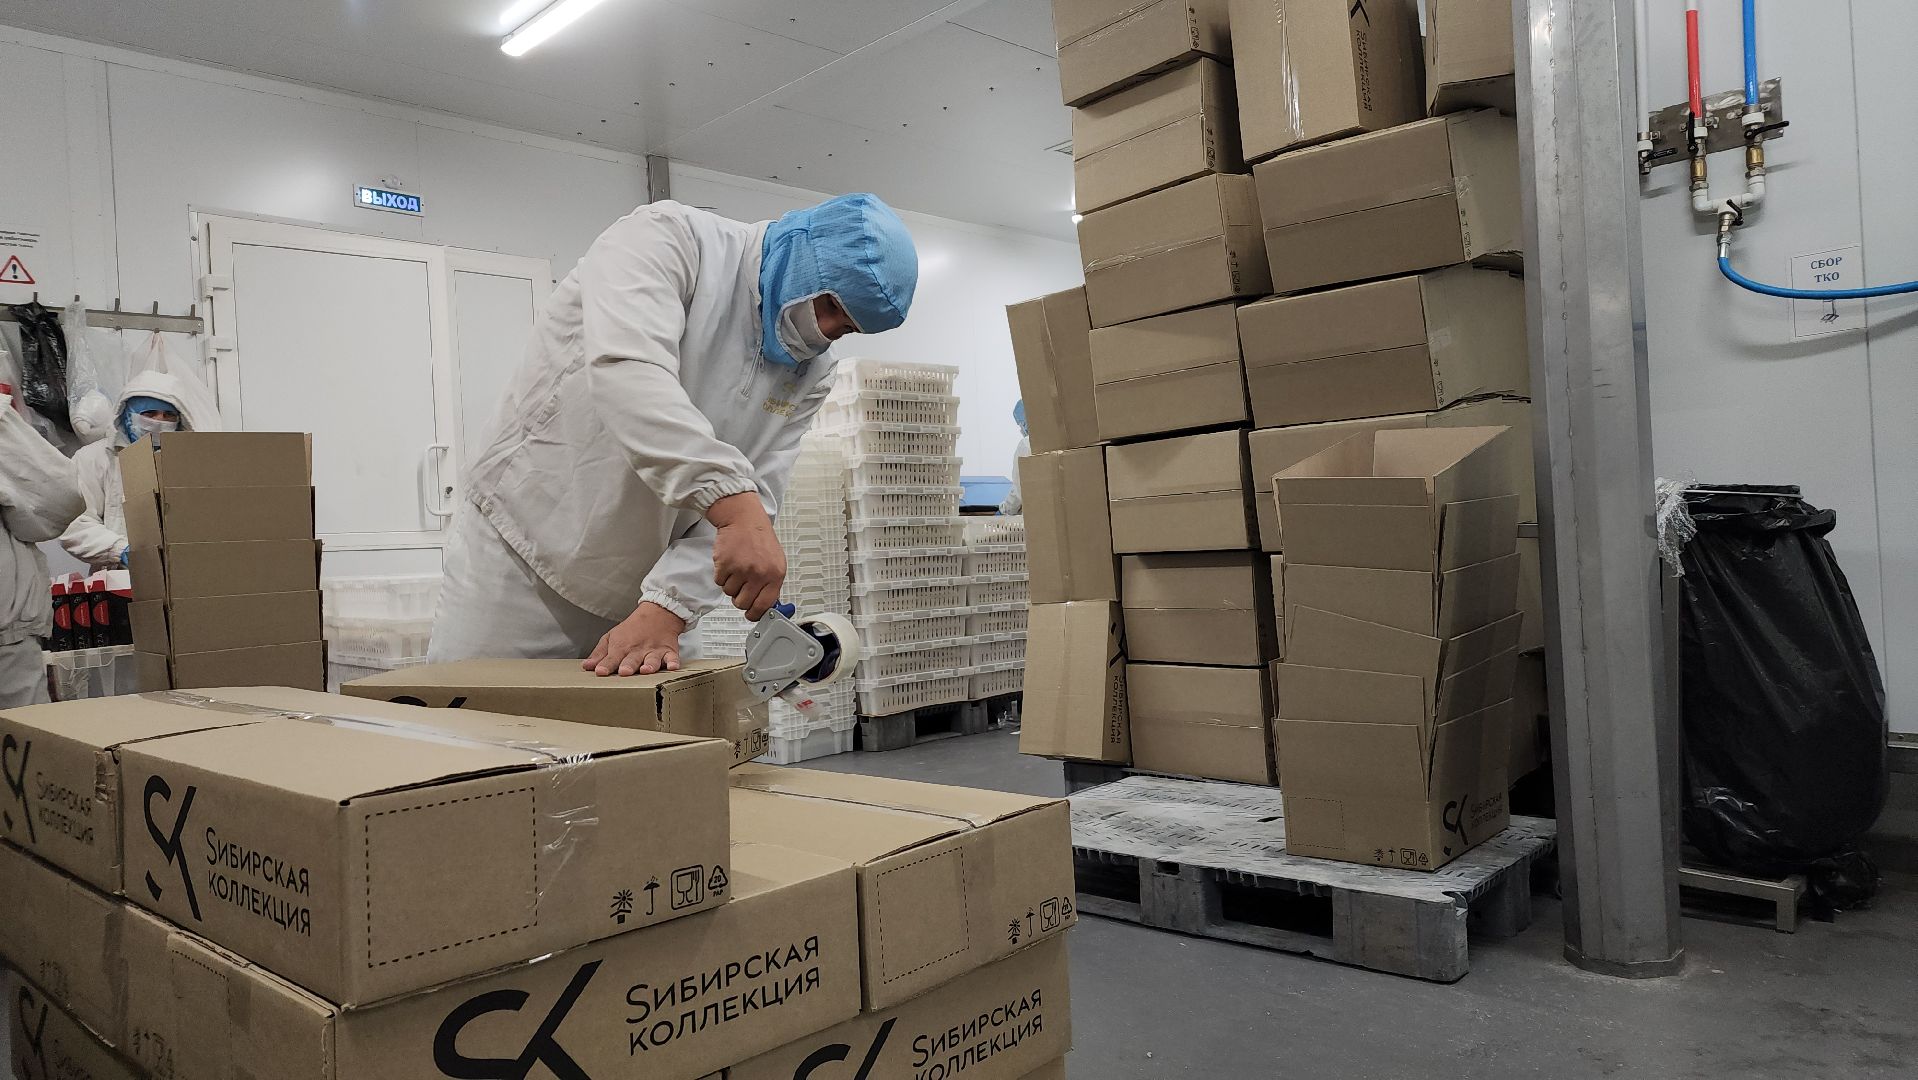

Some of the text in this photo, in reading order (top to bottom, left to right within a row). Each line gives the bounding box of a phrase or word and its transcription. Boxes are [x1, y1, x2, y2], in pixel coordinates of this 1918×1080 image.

[361, 188, 419, 211] ВЫХОД
[1810, 256, 1842, 270] СБОР
[1814, 271, 1840, 283] ТКО
[206, 826, 310, 897] SИБИРСКАЯ
[207, 869, 312, 937] КОЛЛЕКЦИЯ
[626, 935, 819, 1024] SИБИРСКАЯ
[629, 966, 820, 1057] КОЛЛЕКЦИЯ
[912, 988, 1042, 1068] SИБИРСКАЯ
